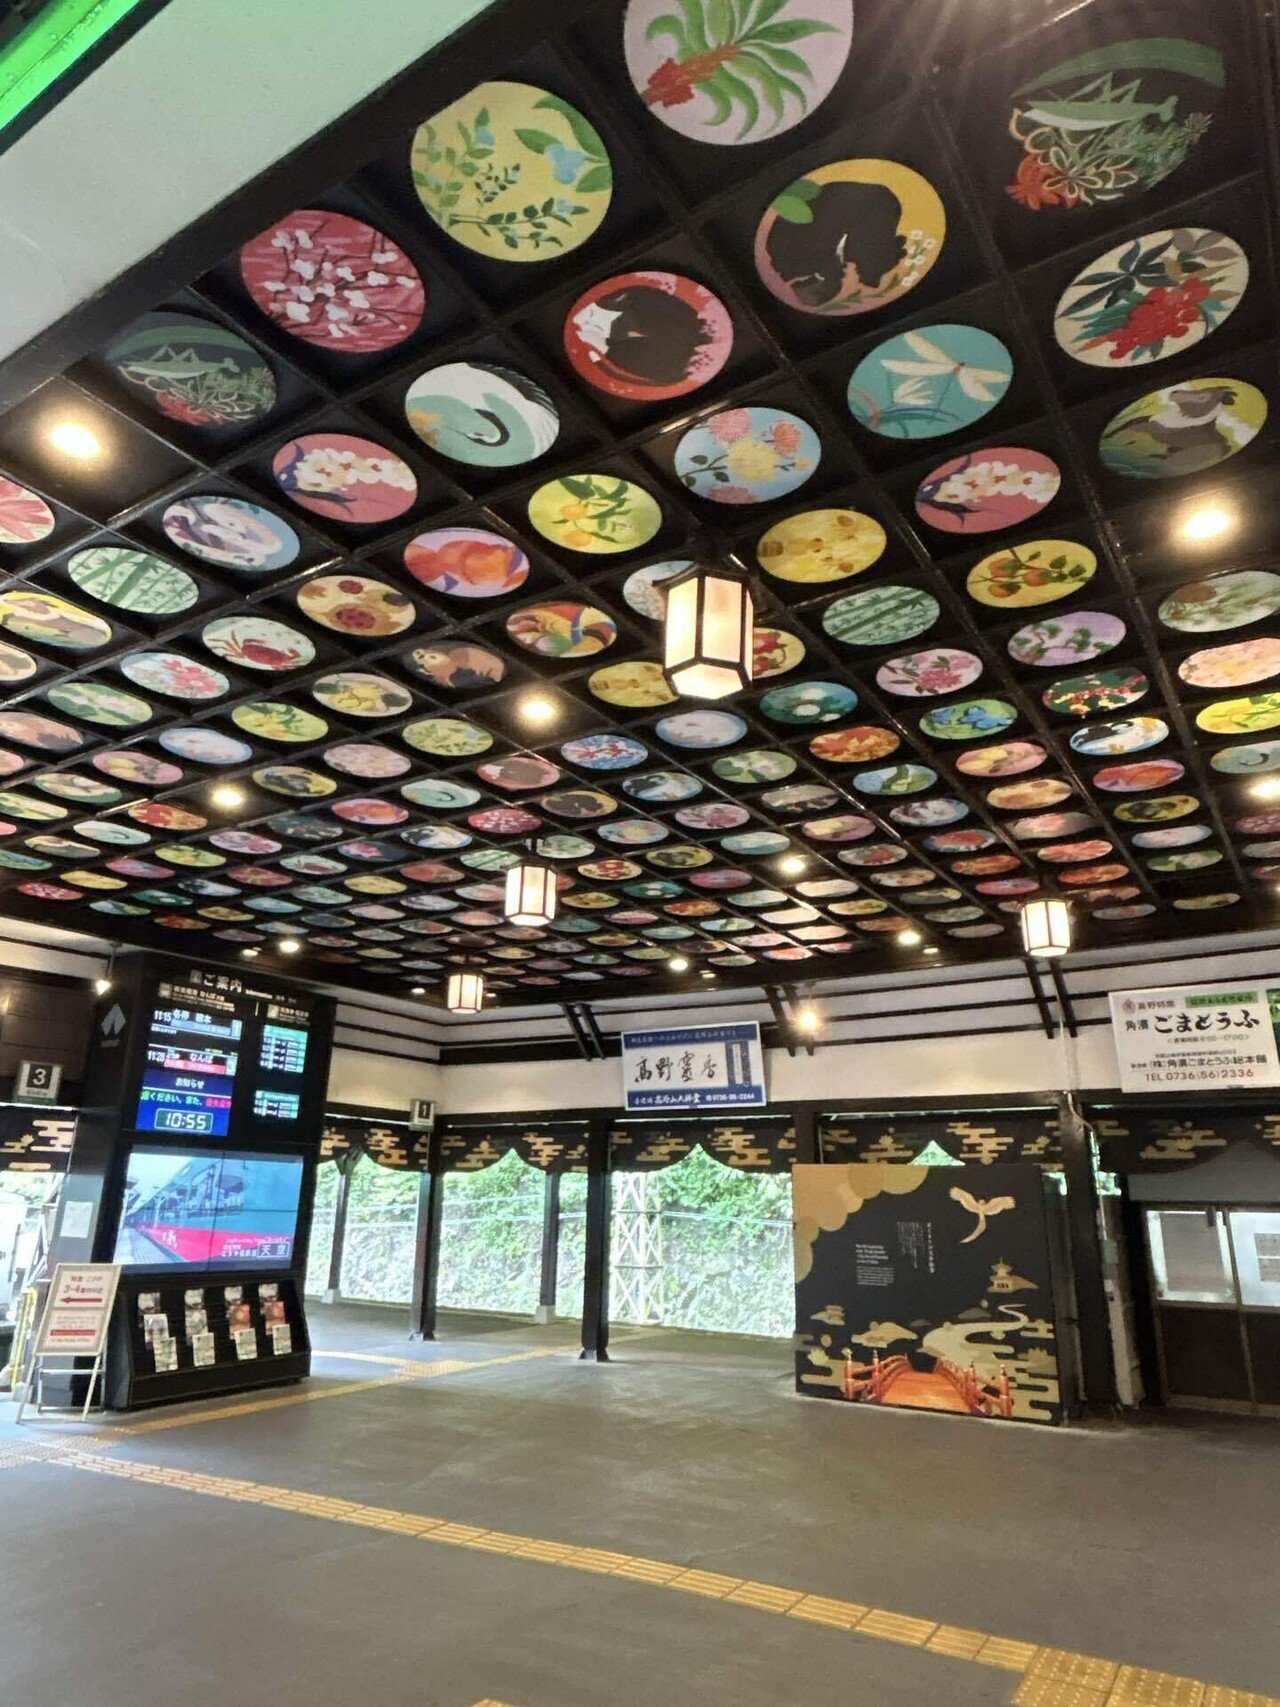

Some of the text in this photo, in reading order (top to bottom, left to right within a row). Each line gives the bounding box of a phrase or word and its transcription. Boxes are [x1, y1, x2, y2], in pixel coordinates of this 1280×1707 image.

[204, 973, 243, 993] ご案内
[153, 1009, 172, 1023] 11:15
[1154, 1009, 1260, 1034] ごまとうふ
[189, 1051, 214, 1064] なんば
[33, 1068, 47, 1085] 3
[175, 1077, 205, 1089] お知らせ
[165, 1112, 207, 1130] 10:55
